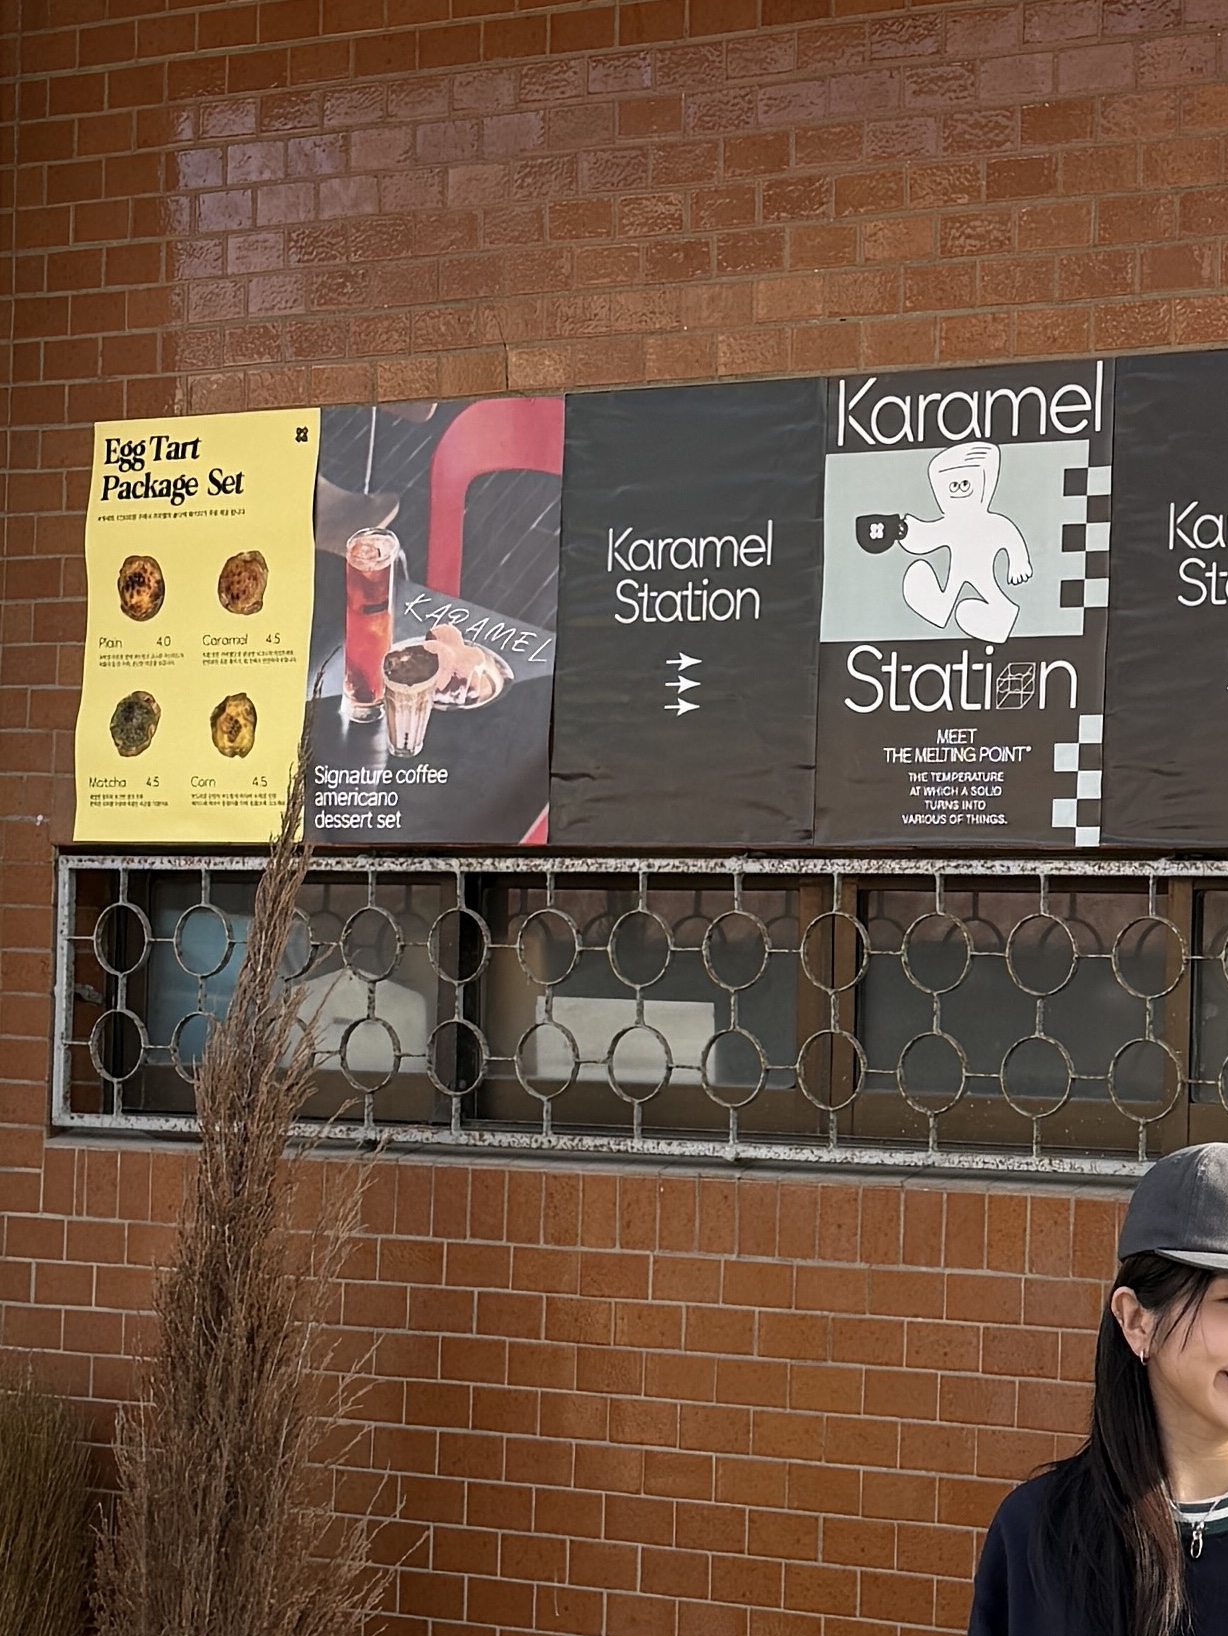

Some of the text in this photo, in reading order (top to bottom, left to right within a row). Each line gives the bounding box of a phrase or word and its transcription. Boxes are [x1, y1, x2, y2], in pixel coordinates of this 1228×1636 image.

[837, 360, 1103, 446] Karamel
[104, 435, 202, 472] Egg Tart
[100, 468, 246, 506] Package Set
[607, 519, 773, 572] Karamel
[614, 578, 761, 624] Station
[936, 728, 978, 744] MEET
[883, 747, 912, 763] THE
[914, 747, 977, 763] MELTING
[88, 776, 127, 789] Matcha
[314, 763, 449, 789] Signature coffee
[908, 771, 1005, 783] THE TEMPERATURE
[314, 787, 398, 807] americano
[909, 785, 1003, 797] AT WHICH A SOLID
[924, 800, 987, 811] TURNS INTO
[314, 810, 402, 829] dessert set
[901, 814, 1008, 825] VARIOUS OF THINGS.
